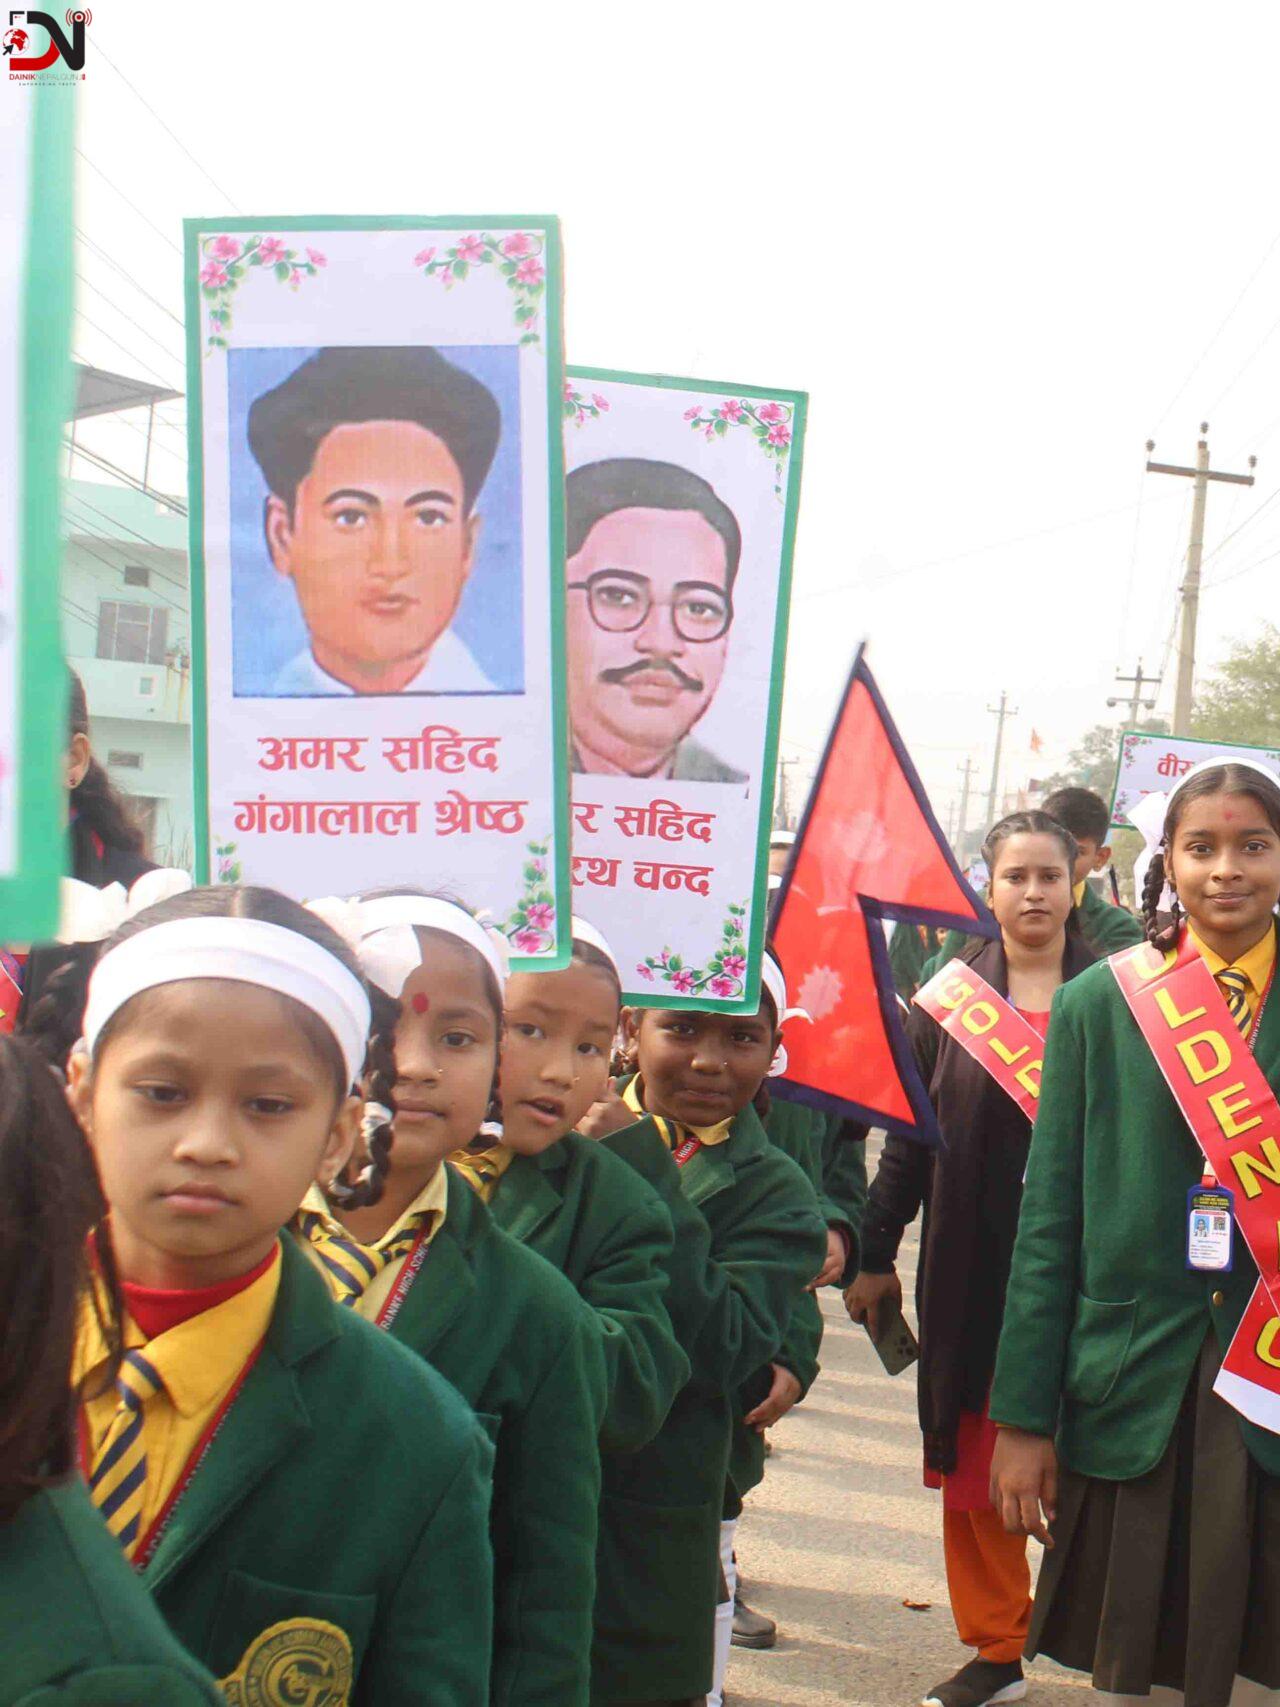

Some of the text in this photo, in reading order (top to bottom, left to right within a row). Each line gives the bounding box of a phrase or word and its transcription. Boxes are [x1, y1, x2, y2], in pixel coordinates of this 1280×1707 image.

[257, 724, 501, 774] अमर सहिद
[234, 789, 529, 836] गंगालाल श्रेष्ठ
[614, 799, 716, 843] सहिद
[633, 861, 715, 897] चन्द
